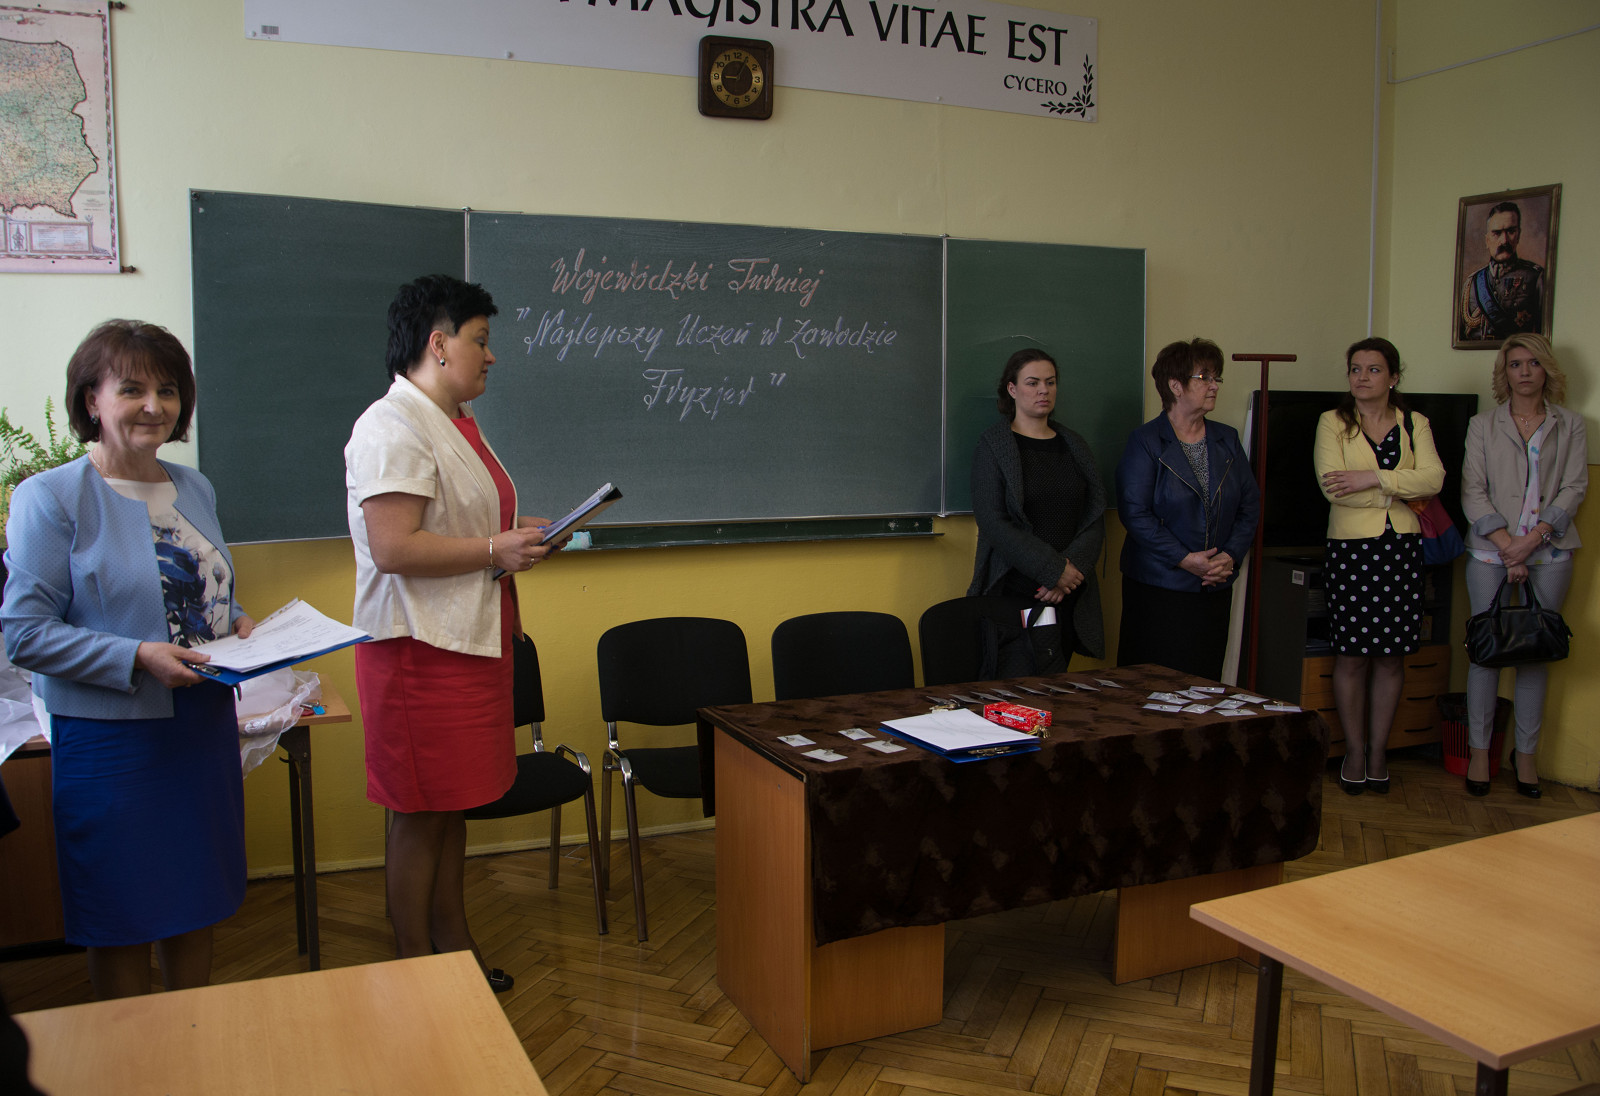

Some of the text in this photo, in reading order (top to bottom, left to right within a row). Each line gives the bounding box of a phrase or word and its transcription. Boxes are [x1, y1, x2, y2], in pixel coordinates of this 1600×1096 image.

[588, 0, 1068, 66] GISTRA VITAE EST
[1003, 74, 1067, 96] CYCERO
[550, 248, 824, 307] Wojewódzki Turniej
[676, 314, 753, 354] Uczeń
[760, 317, 783, 346] w
[784, 316, 898, 359] Zawodzie
